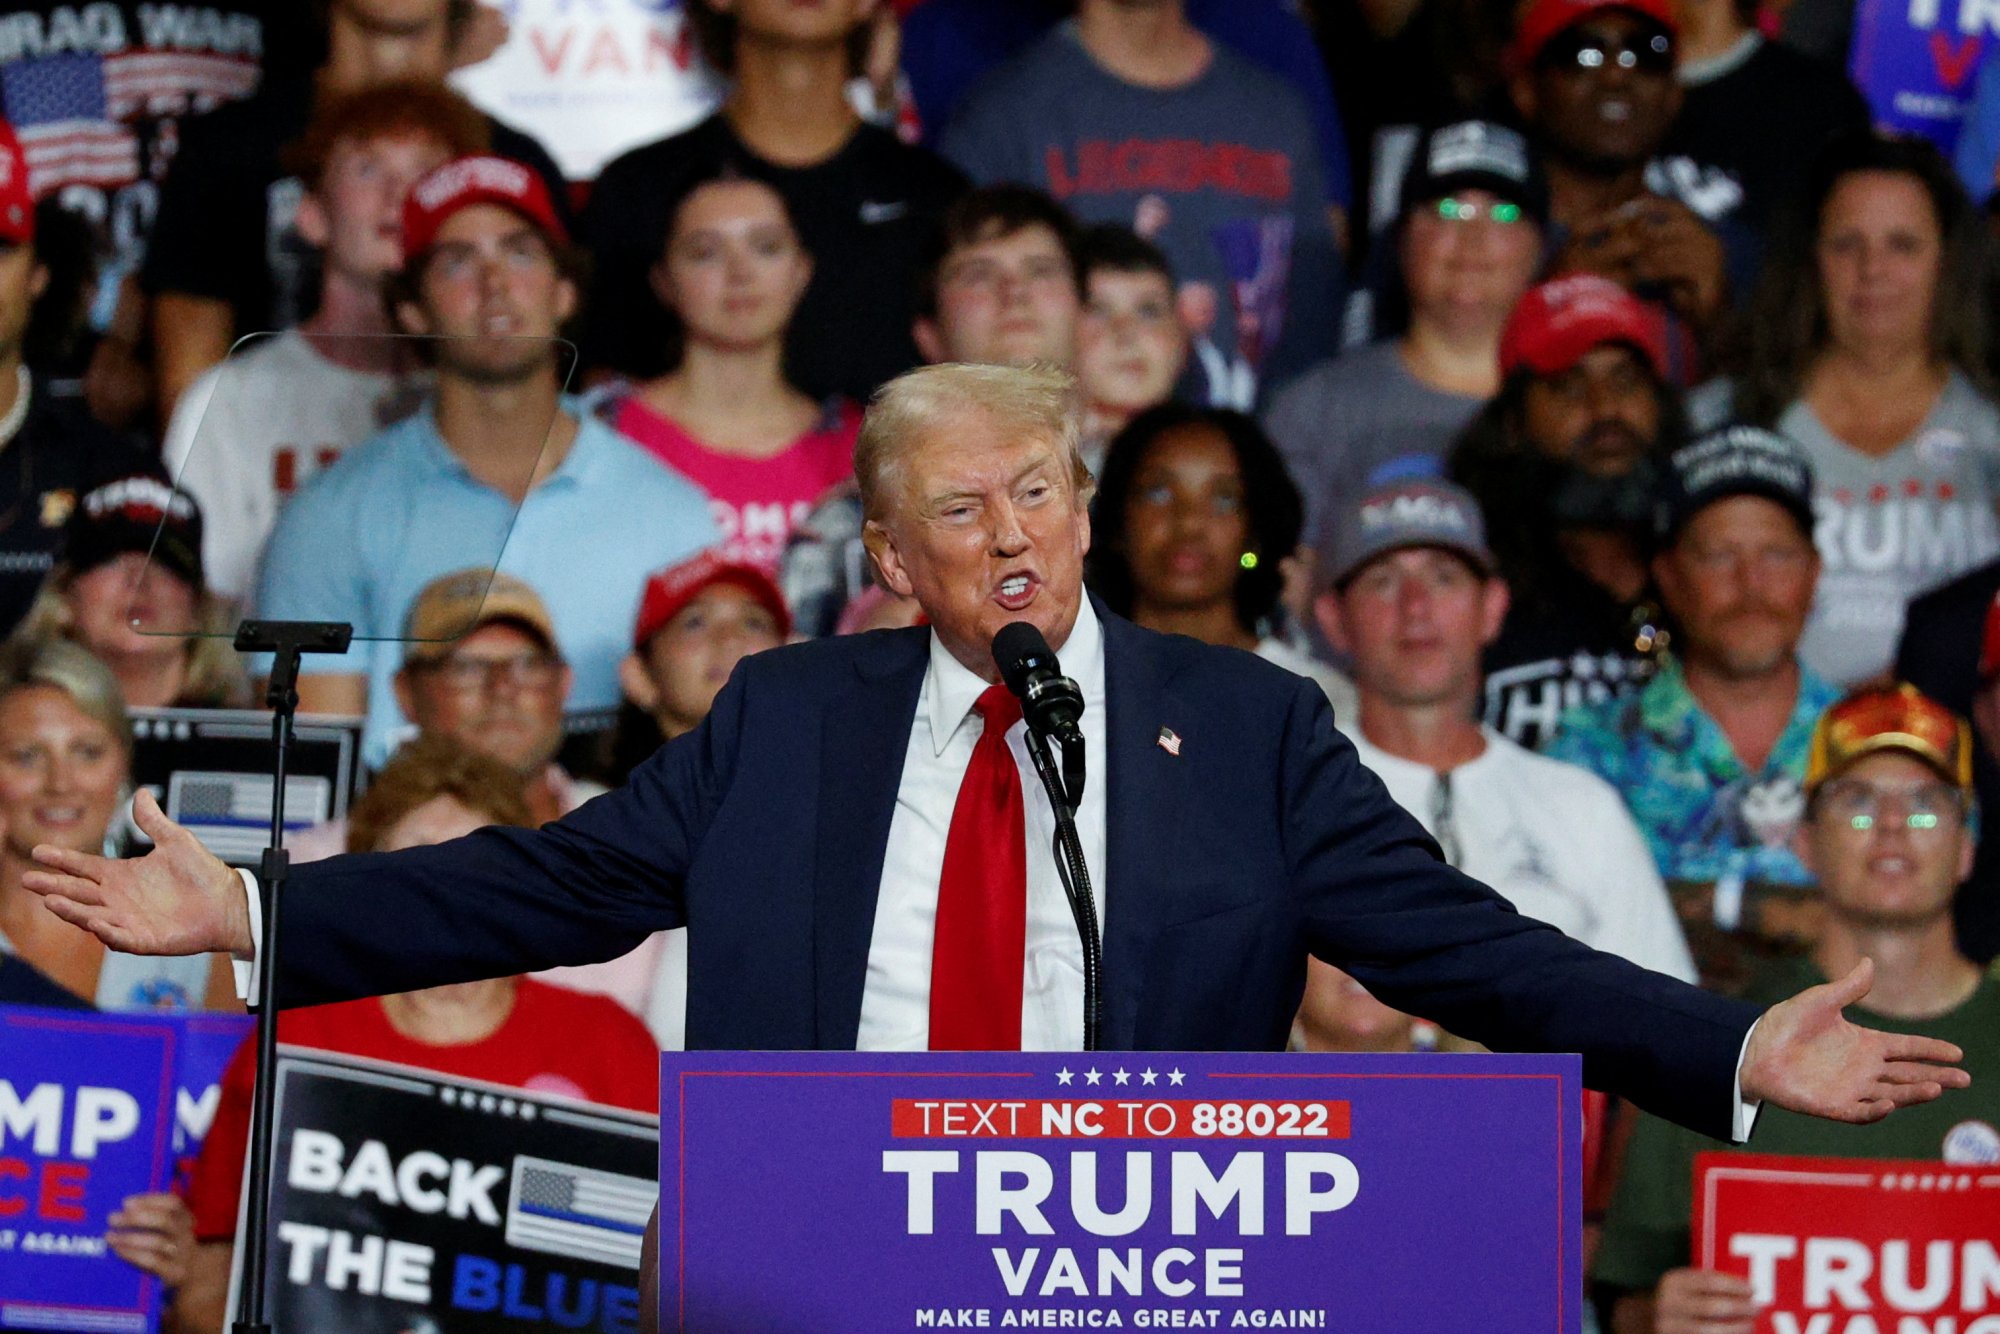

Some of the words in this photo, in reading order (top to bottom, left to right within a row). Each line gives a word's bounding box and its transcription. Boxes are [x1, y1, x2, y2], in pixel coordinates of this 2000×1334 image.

[137, 3, 262, 58] WAR
[914, 1102, 1026, 1136] TEXT
[1041, 1102, 1105, 1136] NC
[1117, 1102, 1177, 1136] TO
[1190, 1103, 1329, 1137] 88022
[288, 1128, 506, 1226] BACK
[882, 1150, 1361, 1237] TRUMP
[277, 1221, 436, 1305] THE
[451, 1253, 641, 1334] BLUE
[991, 1246, 1244, 1298] VANCE
[916, 1308, 991, 1328] MAKE
[1000, 1308, 1123, 1328] AMERICA
[1133, 1309, 1221, 1328] GREAT
[1230, 1309, 1326, 1329] AGAIN!
